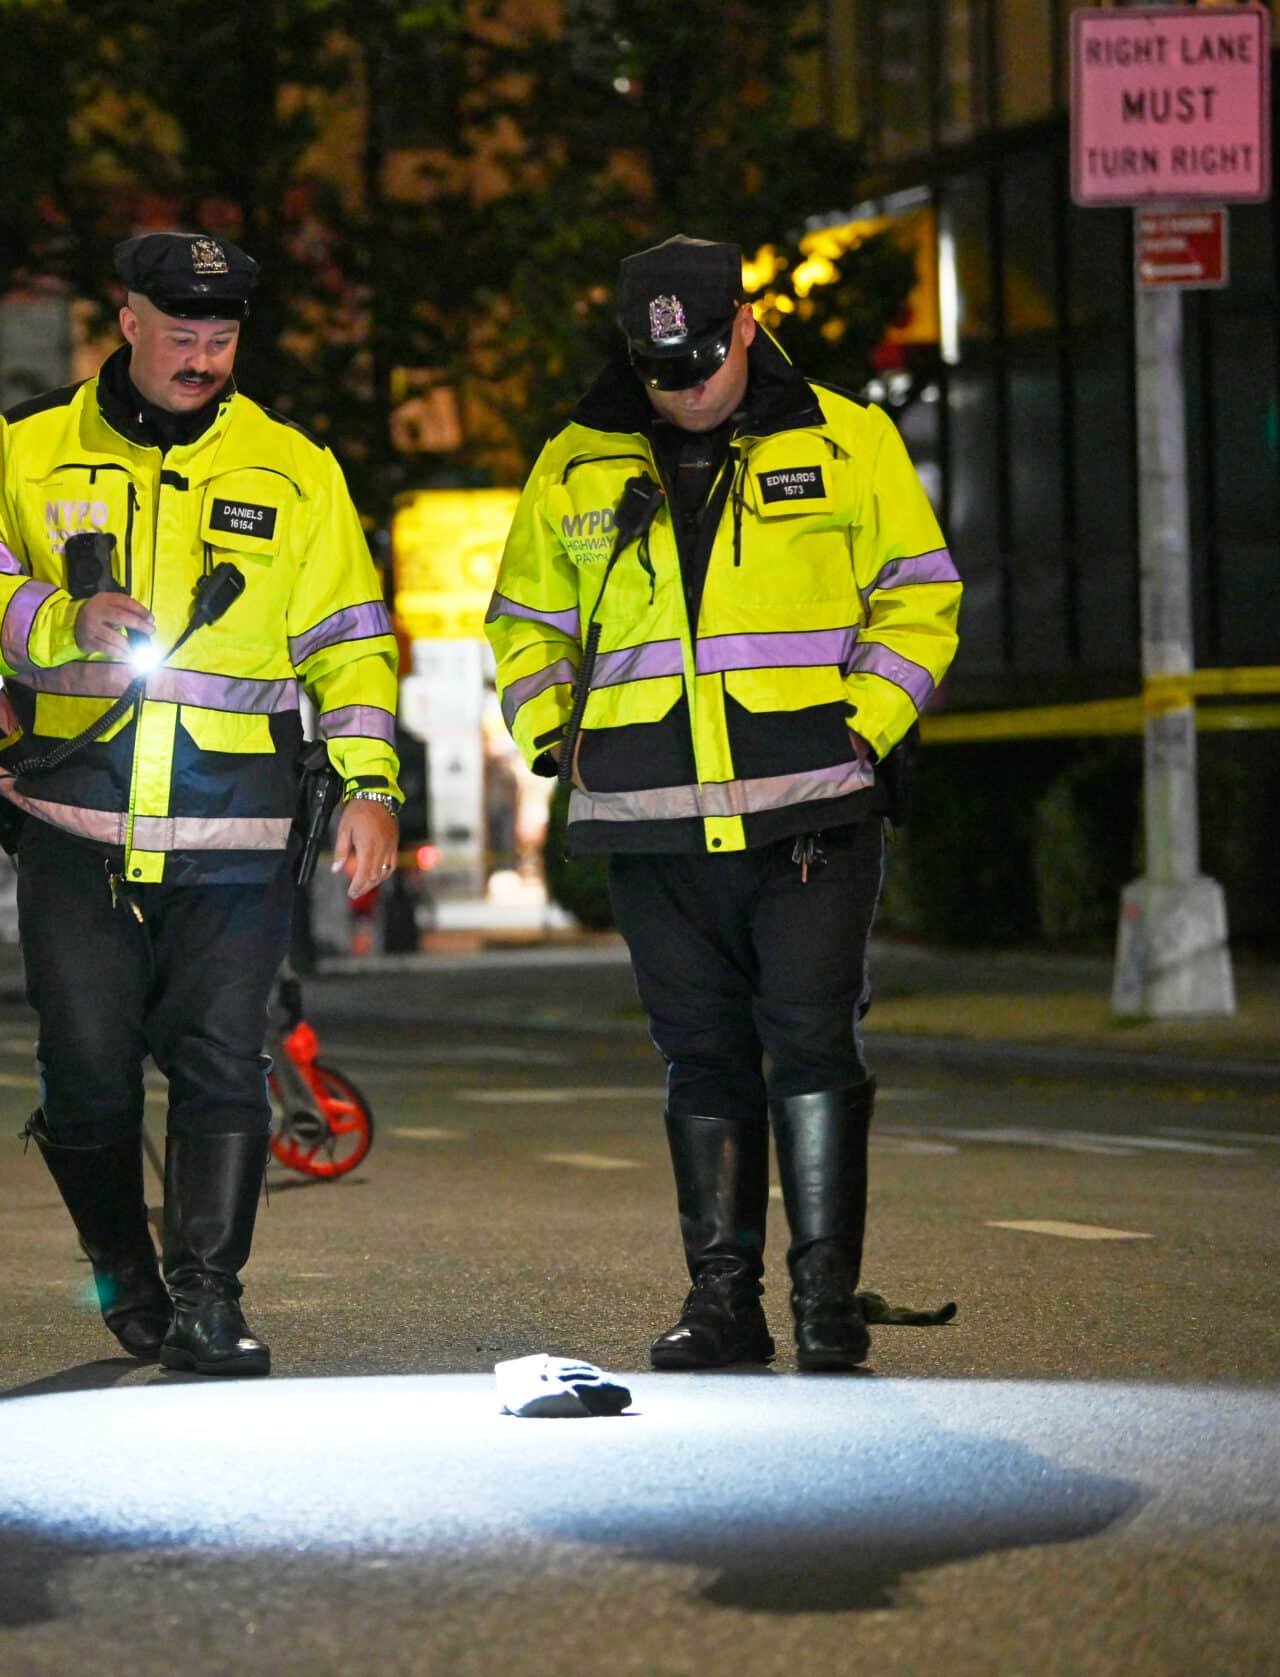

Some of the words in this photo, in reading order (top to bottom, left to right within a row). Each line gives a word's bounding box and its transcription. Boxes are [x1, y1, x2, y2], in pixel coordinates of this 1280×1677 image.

[1085, 36, 1167, 66] RIGHT
[1180, 32, 1253, 64] LANE
[1121, 86, 1216, 124] MUST
[1088, 147, 1159, 176] TURN
[1171, 144, 1253, 175] RIGHT
[766, 471, 817, 487] EDWARDS
[783, 484, 805, 496] 1573
[45, 500, 107, 526] NYPD
[223, 505, 264, 521] DANIELS
[230, 518, 254, 531] 16154
[561, 508, 616, 538] NYPD
